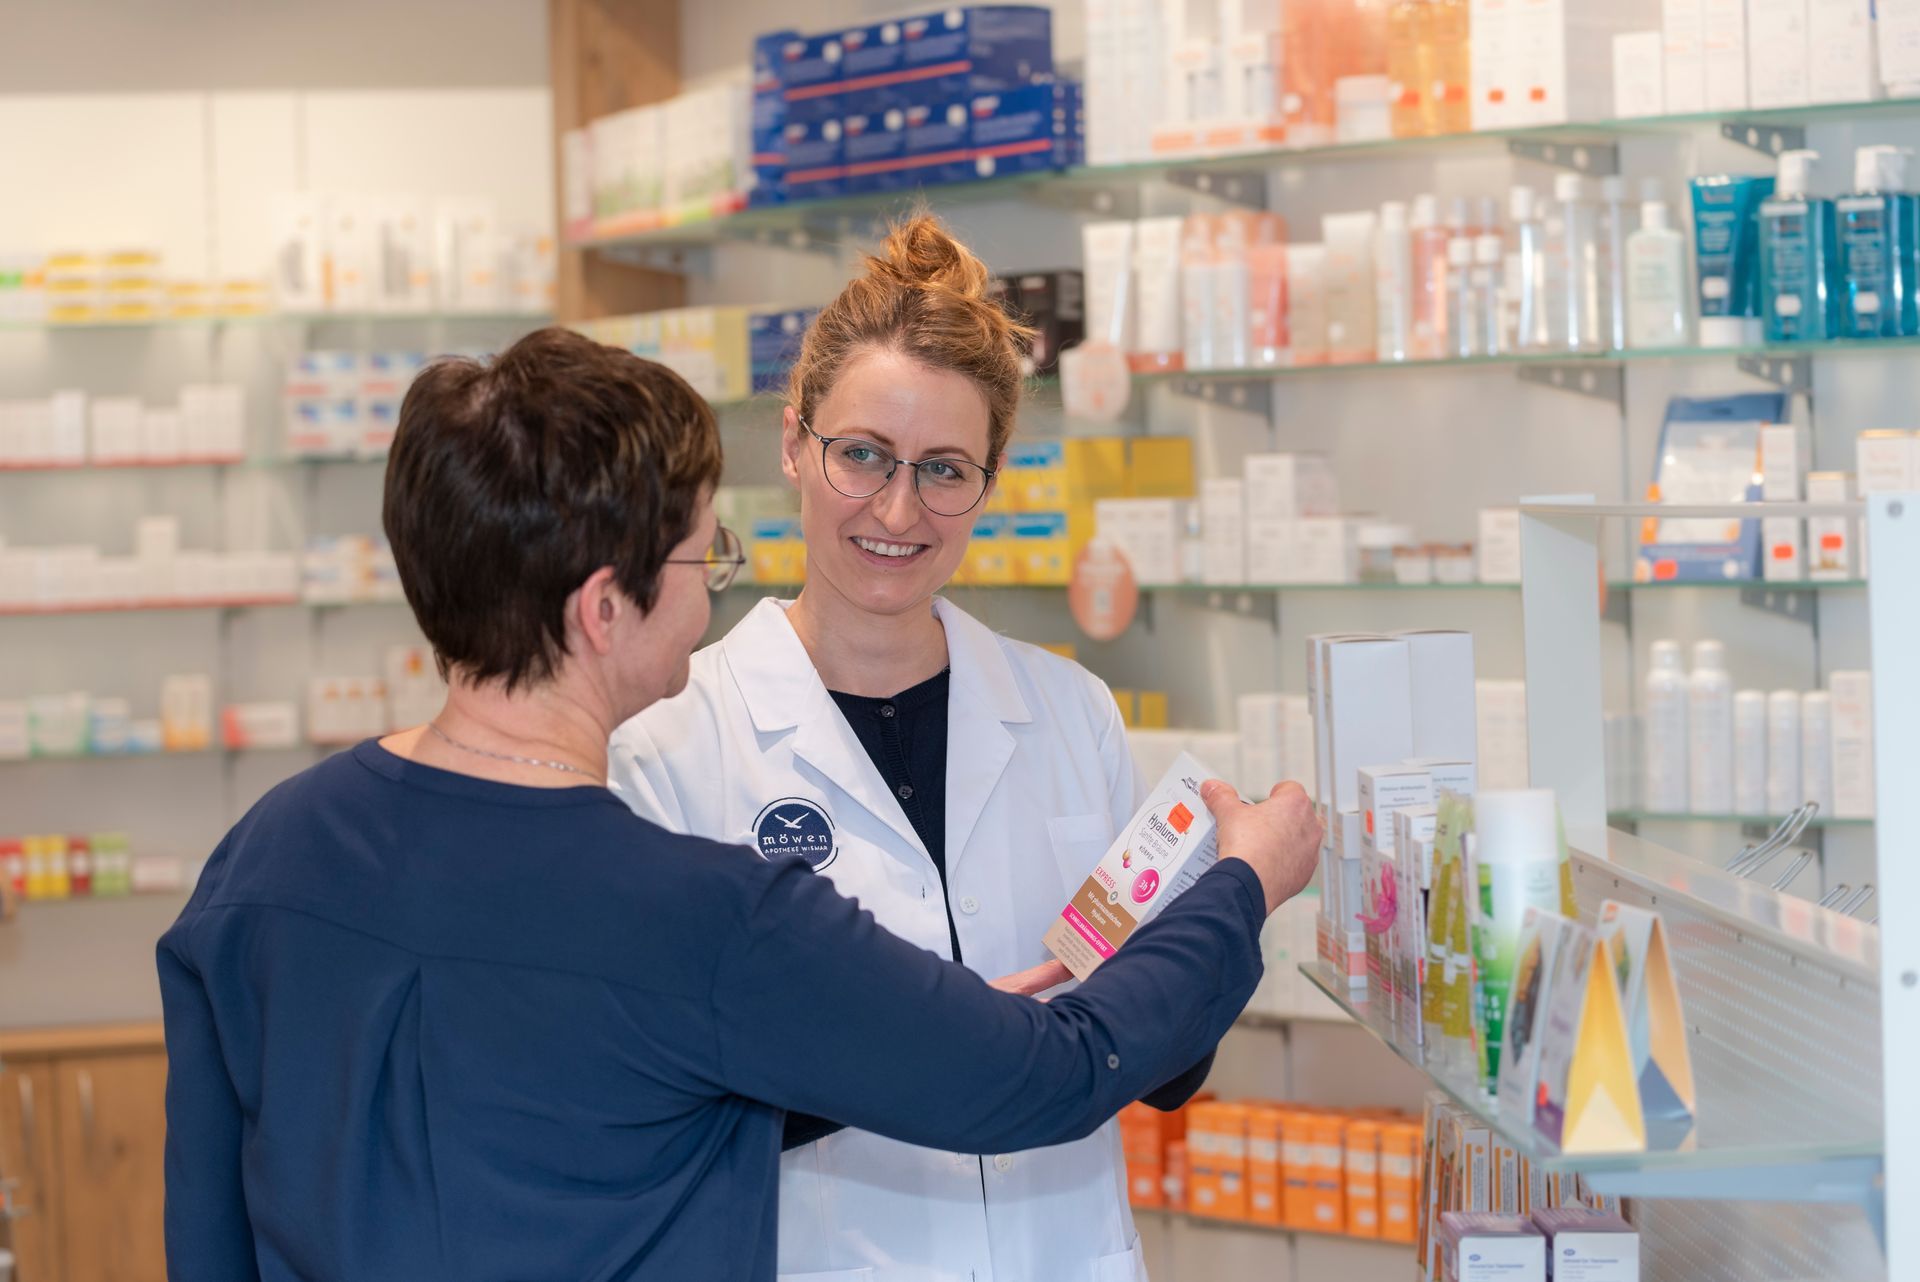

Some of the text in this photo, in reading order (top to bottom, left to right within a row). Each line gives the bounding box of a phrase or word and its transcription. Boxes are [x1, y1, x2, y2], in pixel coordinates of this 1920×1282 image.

[762, 833, 827, 846] möwen
[1139, 827, 1155, 845] Sanfte
[1148, 813, 1179, 847] Hyaluron
[1095, 866, 1116, 889] EXPRESS
